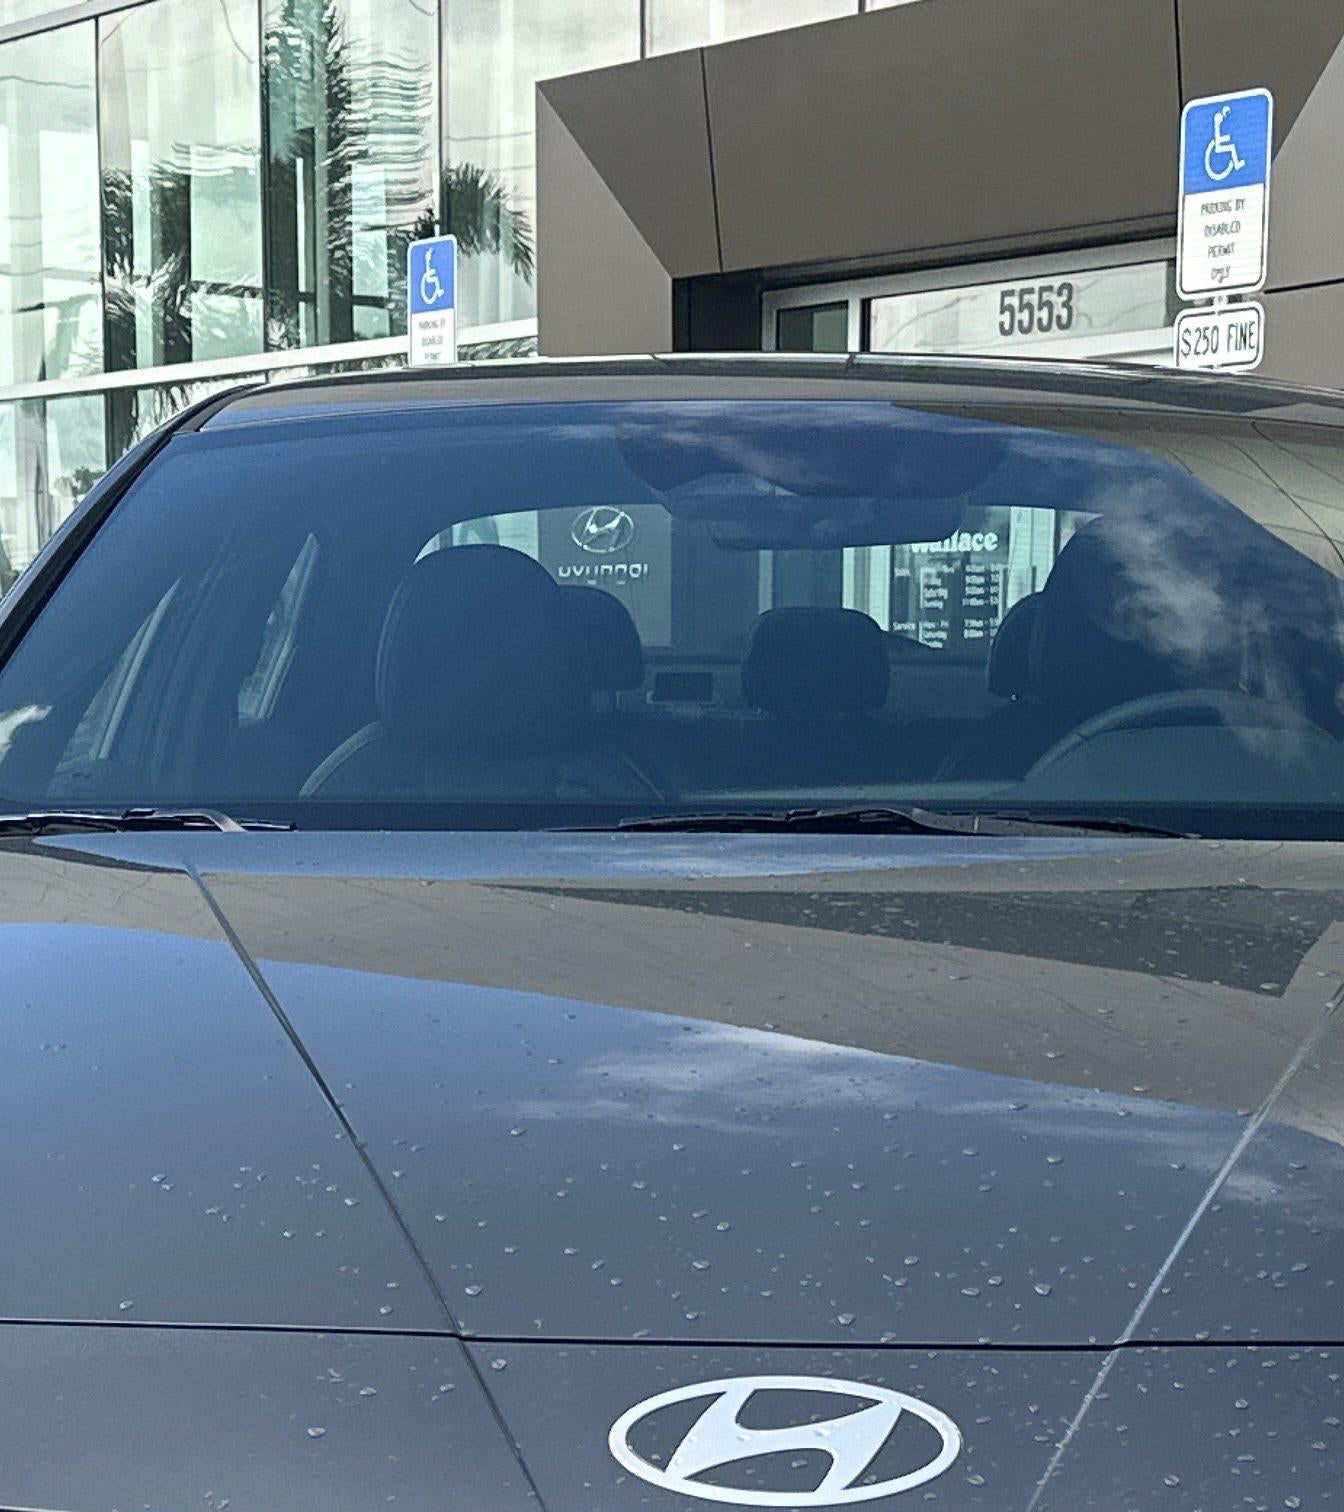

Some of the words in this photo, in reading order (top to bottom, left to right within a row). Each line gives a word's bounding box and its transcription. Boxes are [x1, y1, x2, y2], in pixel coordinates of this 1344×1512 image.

[998, 282, 1074, 337] 5553
[1181, 324, 1220, 359] $250
[1227, 321, 1256, 353] FINE
